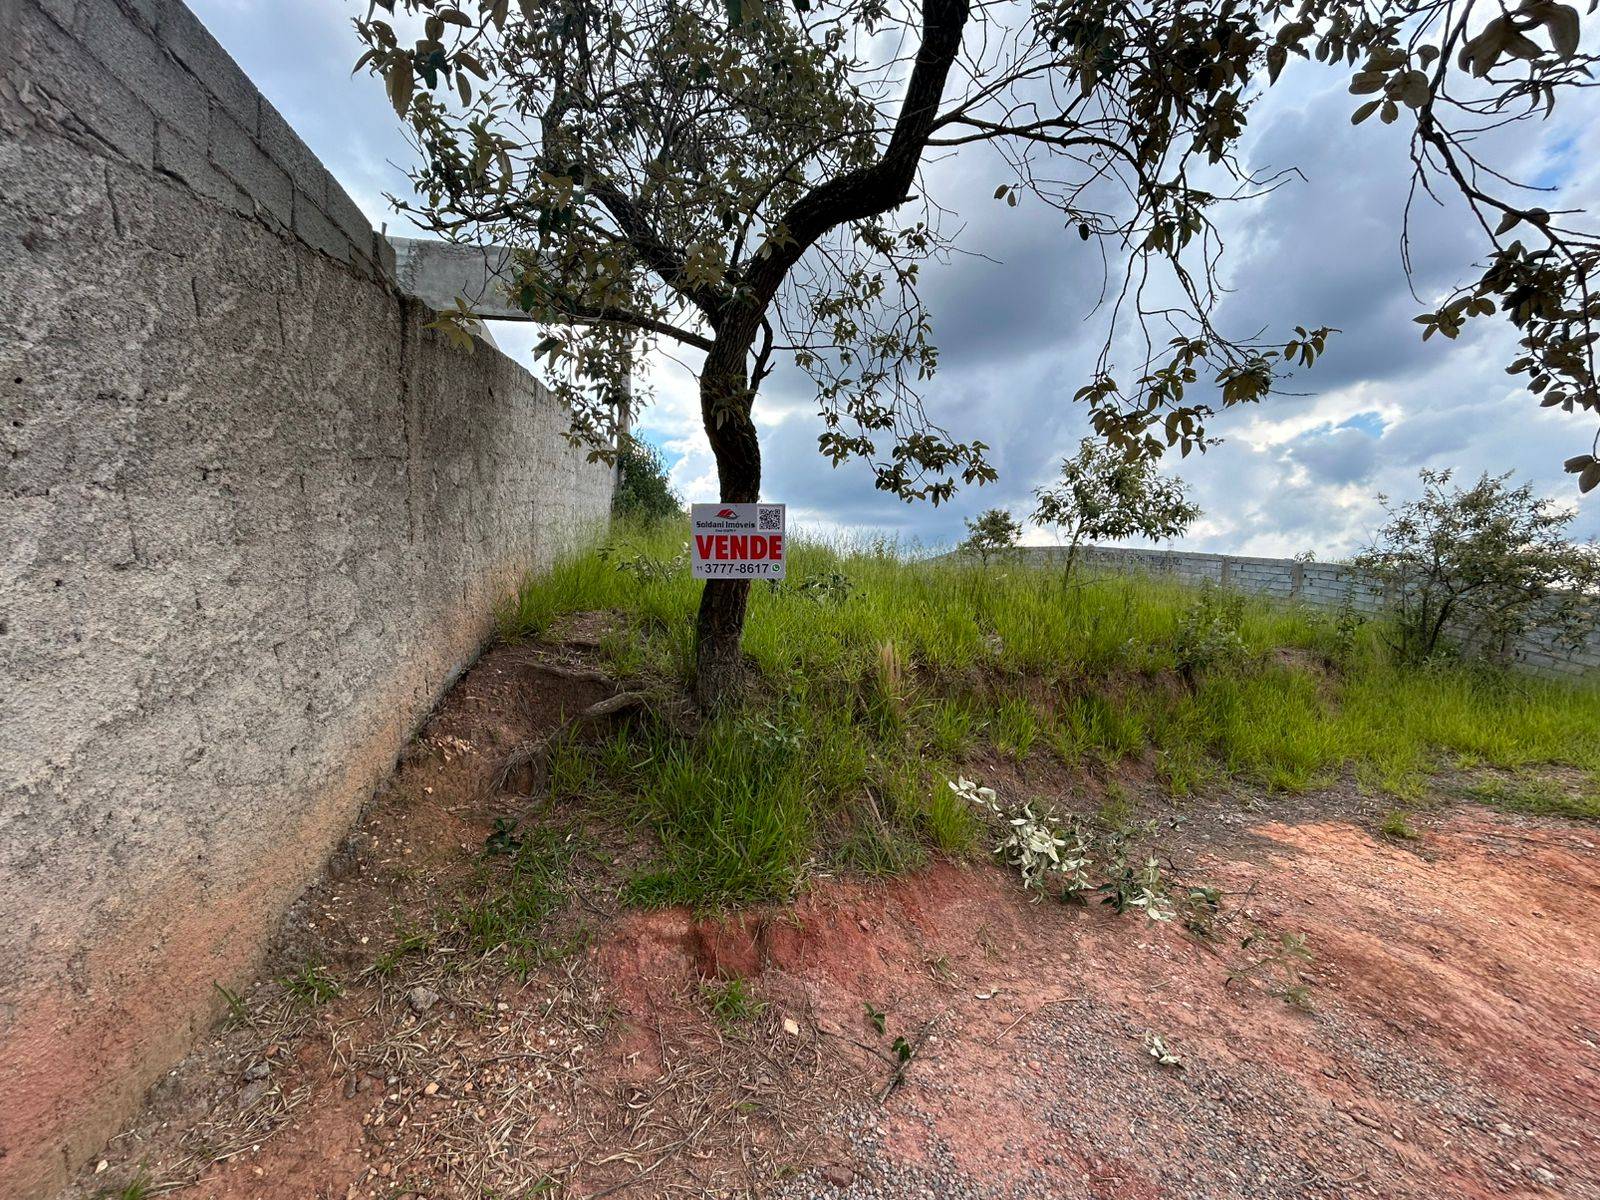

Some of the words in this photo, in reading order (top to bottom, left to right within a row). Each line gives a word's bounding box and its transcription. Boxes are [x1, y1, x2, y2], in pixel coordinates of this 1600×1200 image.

[696, 520, 724, 528] Soldani
[725, 520, 756, 528] Imóveis
[695, 535, 782, 560] VENDE
[704, 563, 769, 574] 3777-8617
